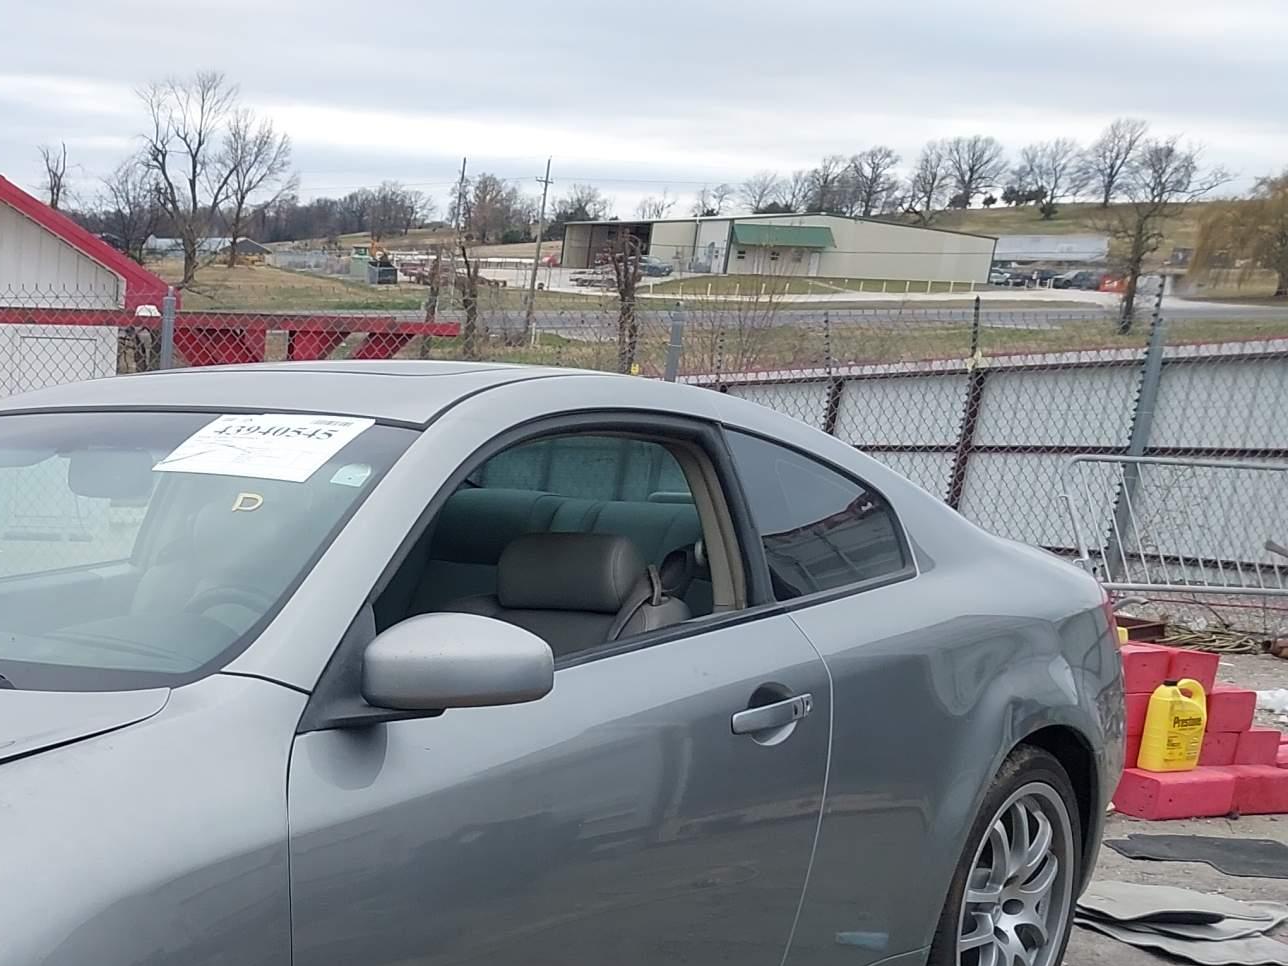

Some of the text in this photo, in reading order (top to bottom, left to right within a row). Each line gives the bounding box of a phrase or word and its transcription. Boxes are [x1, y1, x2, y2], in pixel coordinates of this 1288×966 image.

[213, 425, 338, 440] 43940545
[232, 492, 263, 512] D
[1173, 716, 1202, 728] Prestone
